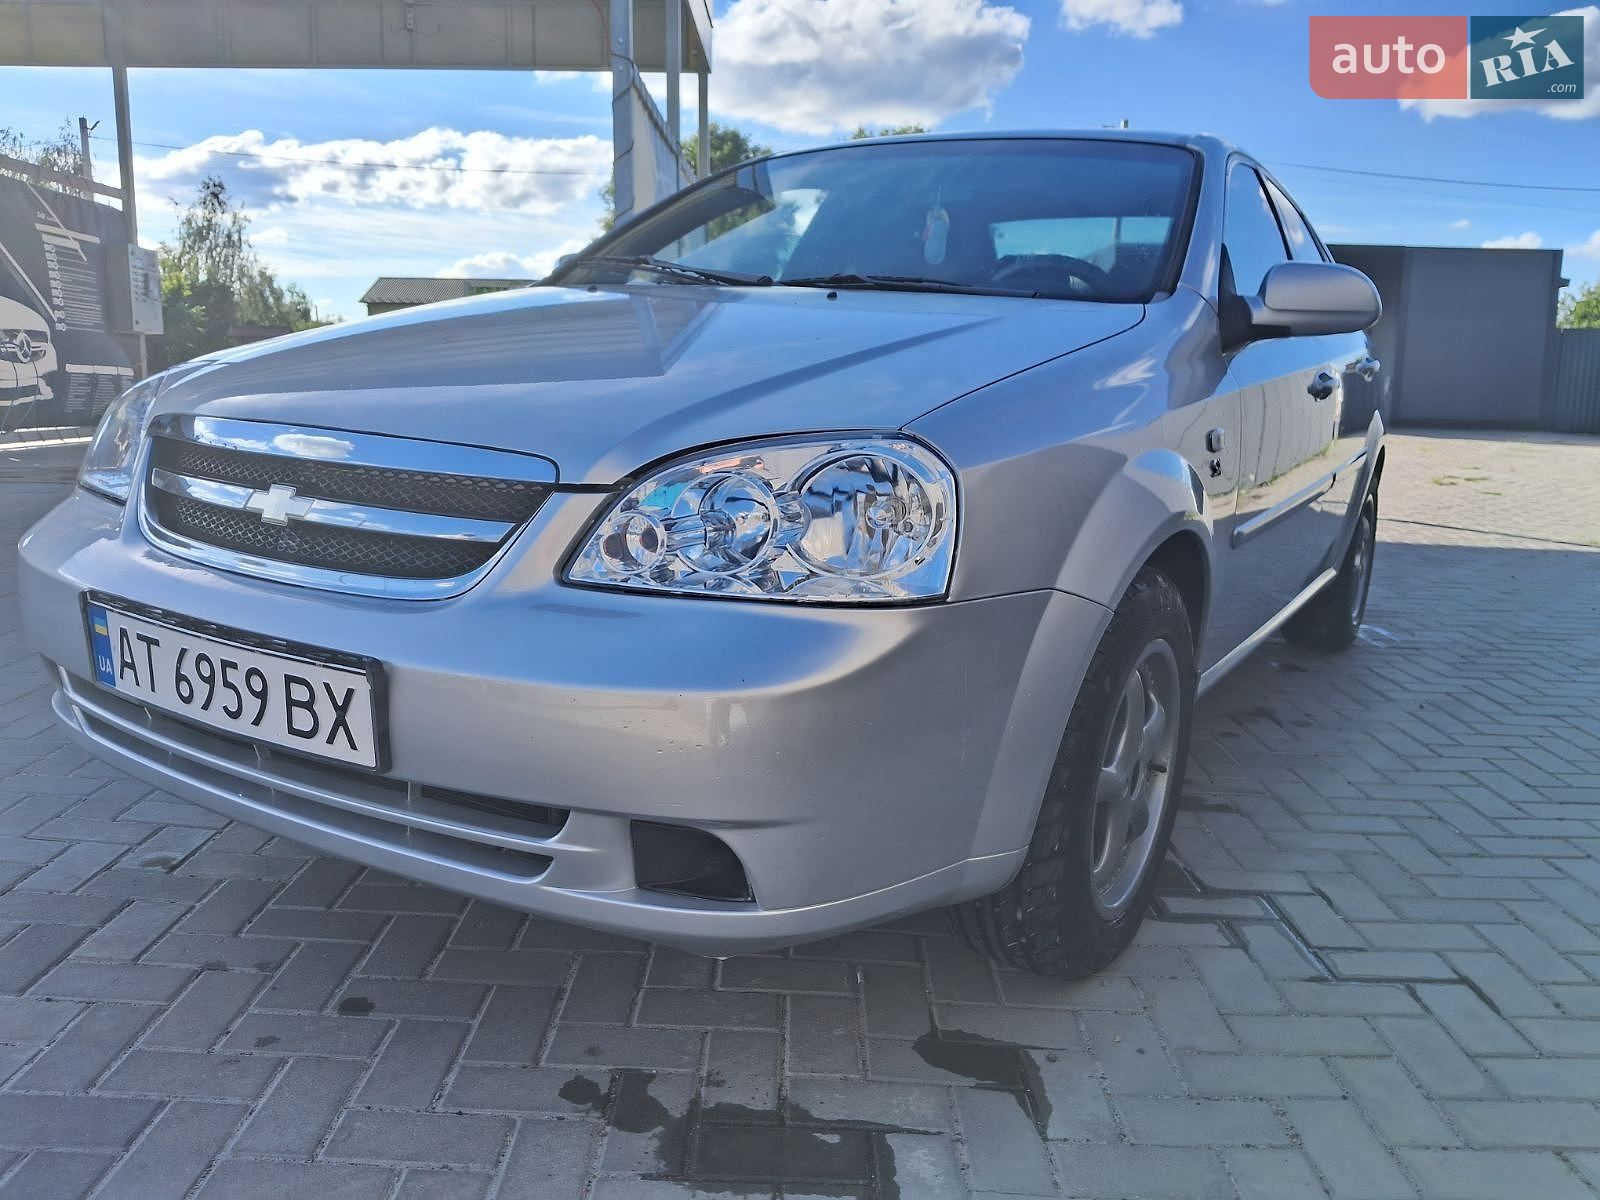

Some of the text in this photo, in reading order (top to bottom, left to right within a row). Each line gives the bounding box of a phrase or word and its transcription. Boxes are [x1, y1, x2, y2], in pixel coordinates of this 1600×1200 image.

[98, 655, 113, 675] UA
[119, 626, 359, 751] AT 6959 BX
